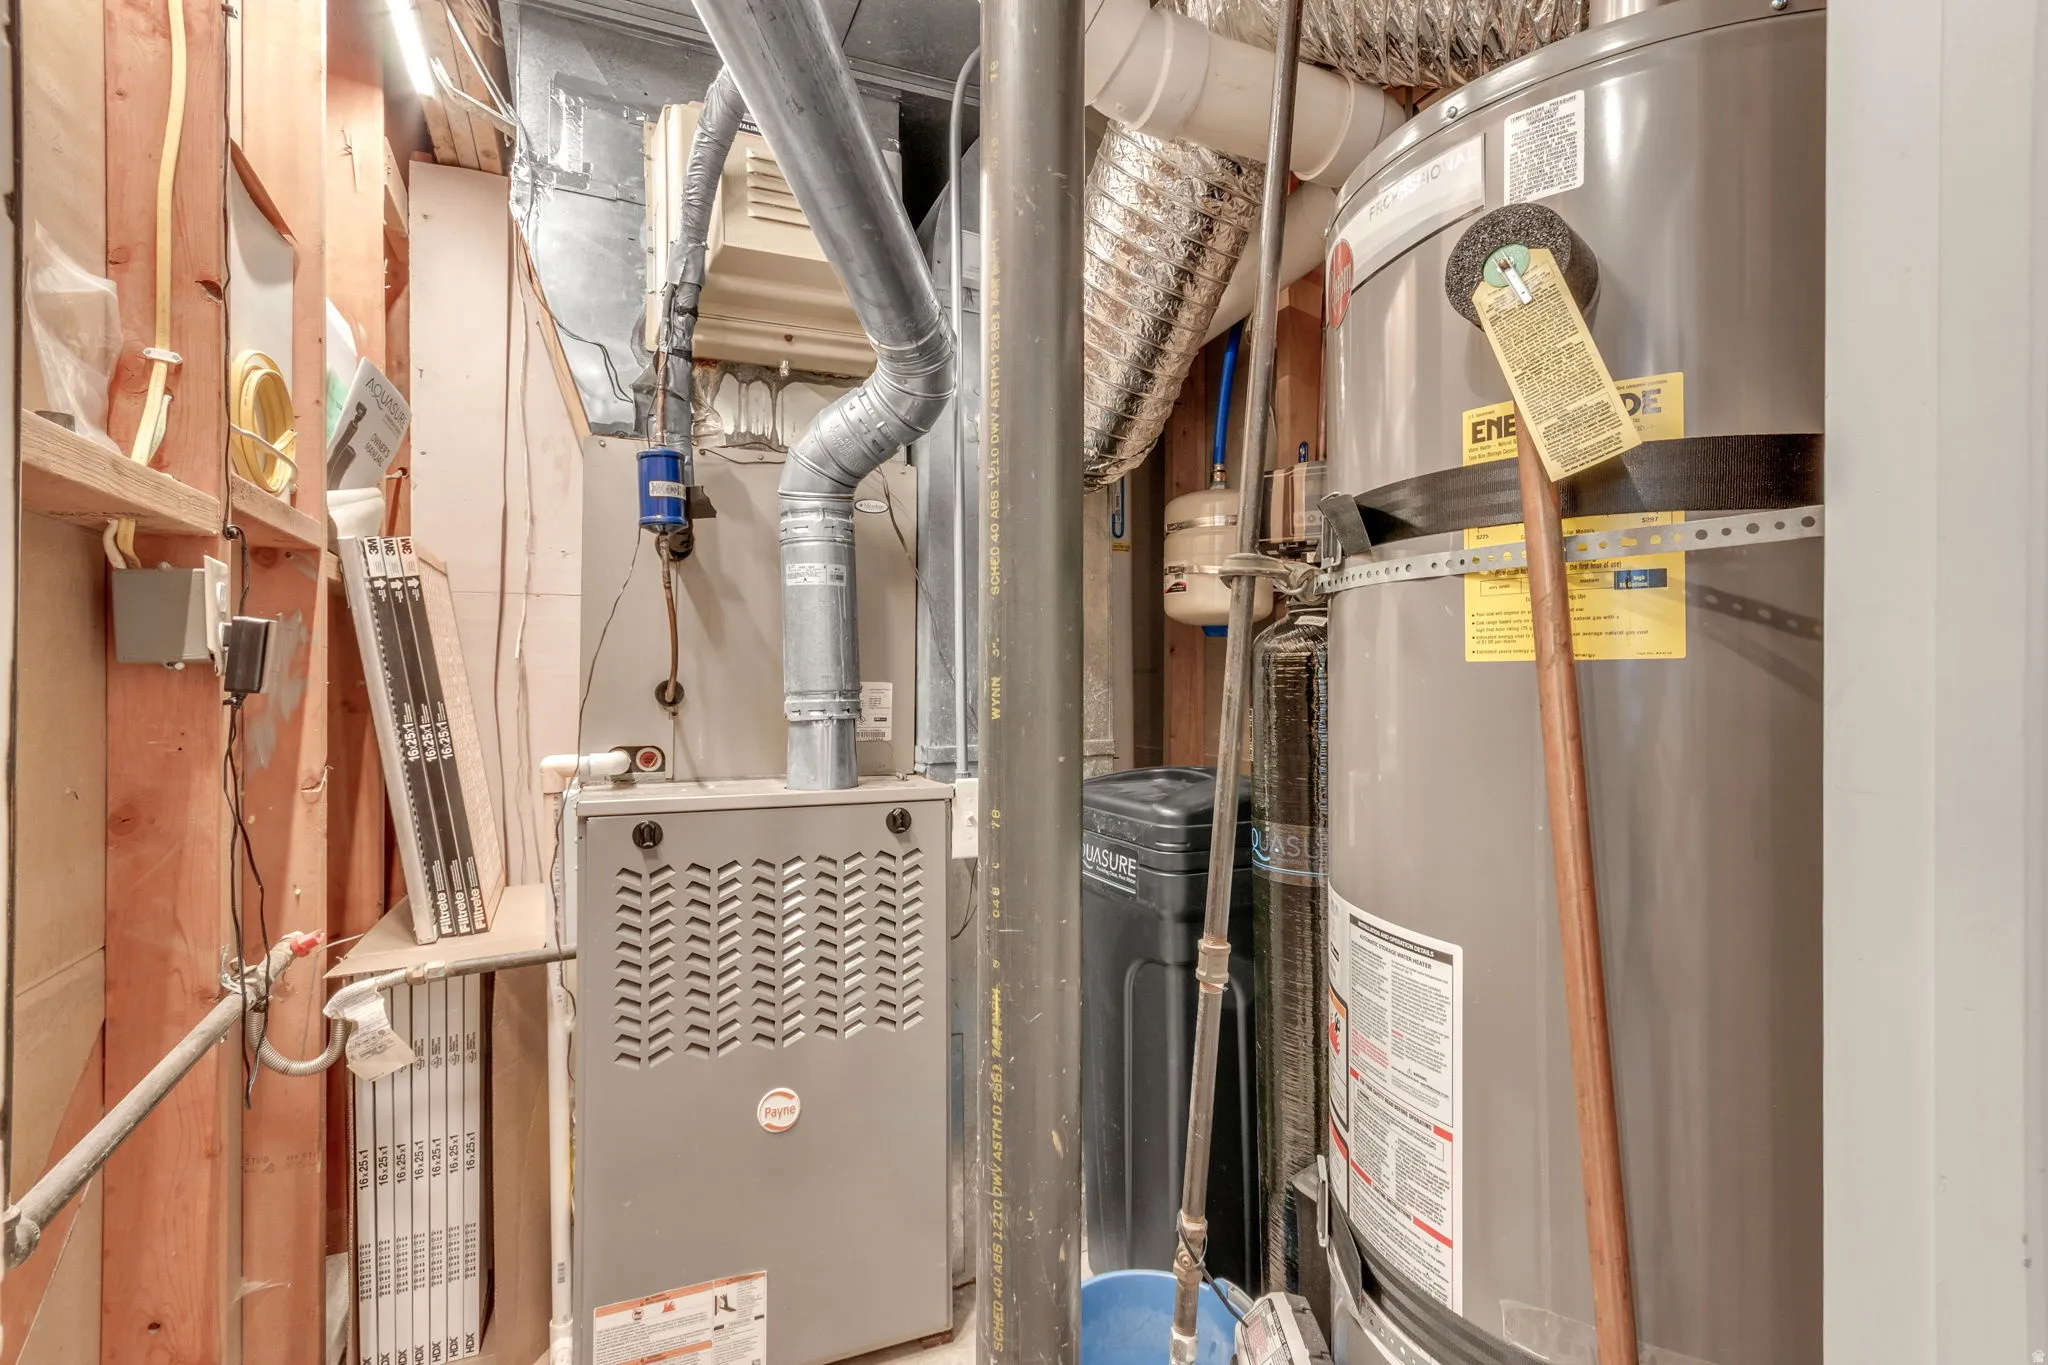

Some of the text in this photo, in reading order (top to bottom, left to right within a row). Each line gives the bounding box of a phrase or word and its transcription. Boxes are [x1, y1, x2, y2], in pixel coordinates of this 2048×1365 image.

[990, 413, 1000, 443] DWV
[990, 490, 1000, 519] ABS
[367, 538, 379, 555] 3M
[384, 539, 396, 556] 3M
[401, 538, 413, 555] 3M
[990, 523, 1000, 543] 40
[990, 547, 1000, 596] SCHED
[991, 675, 1001, 720] WYNN
[402, 723, 420, 762] 16x25x1
[419, 723, 437, 762] 16x25x1
[436, 721, 453, 760] 16x25x1
[437, 891, 453, 935] Filtrete
[455, 891, 471, 934] Filtrete
[471, 888, 487, 930] Filtrete
[1413, 958, 1432, 969] HEATER
[764, 1105, 796, 1120] Payne
[991, 1118, 1002, 1162] ASTM
[992, 1199, 1003, 1240] 1210
[992, 1243, 1003, 1275] ABS
[992, 1276, 1003, 1298] 40
[992, 1300, 1004, 1352] SCHED
[432, 1340, 442, 1363] HDX
[450, 1336, 459, 1358] HDX
[465, 1332, 475, 1354] HDX
